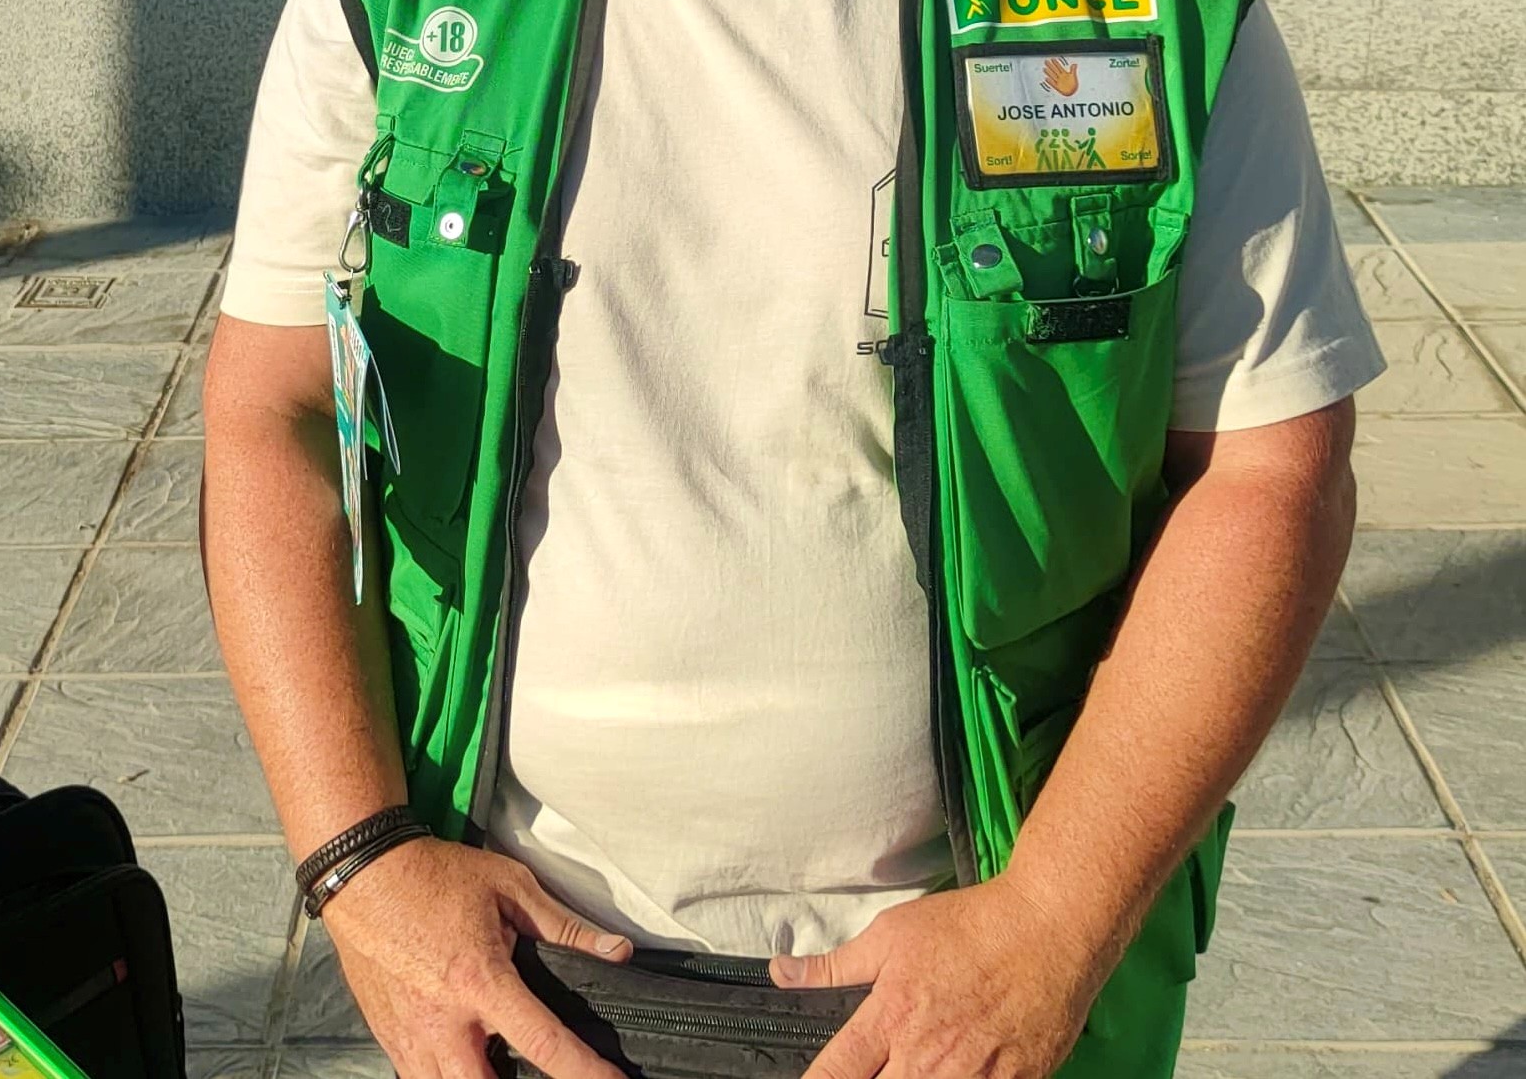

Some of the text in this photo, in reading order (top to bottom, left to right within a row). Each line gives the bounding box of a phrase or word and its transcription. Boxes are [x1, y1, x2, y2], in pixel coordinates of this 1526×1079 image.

[426, 21, 465, 52] +18
[973, 58, 1141, 73] Suerte! Zorte!
[997, 101, 1135, 121] JOSE ANTONIO
